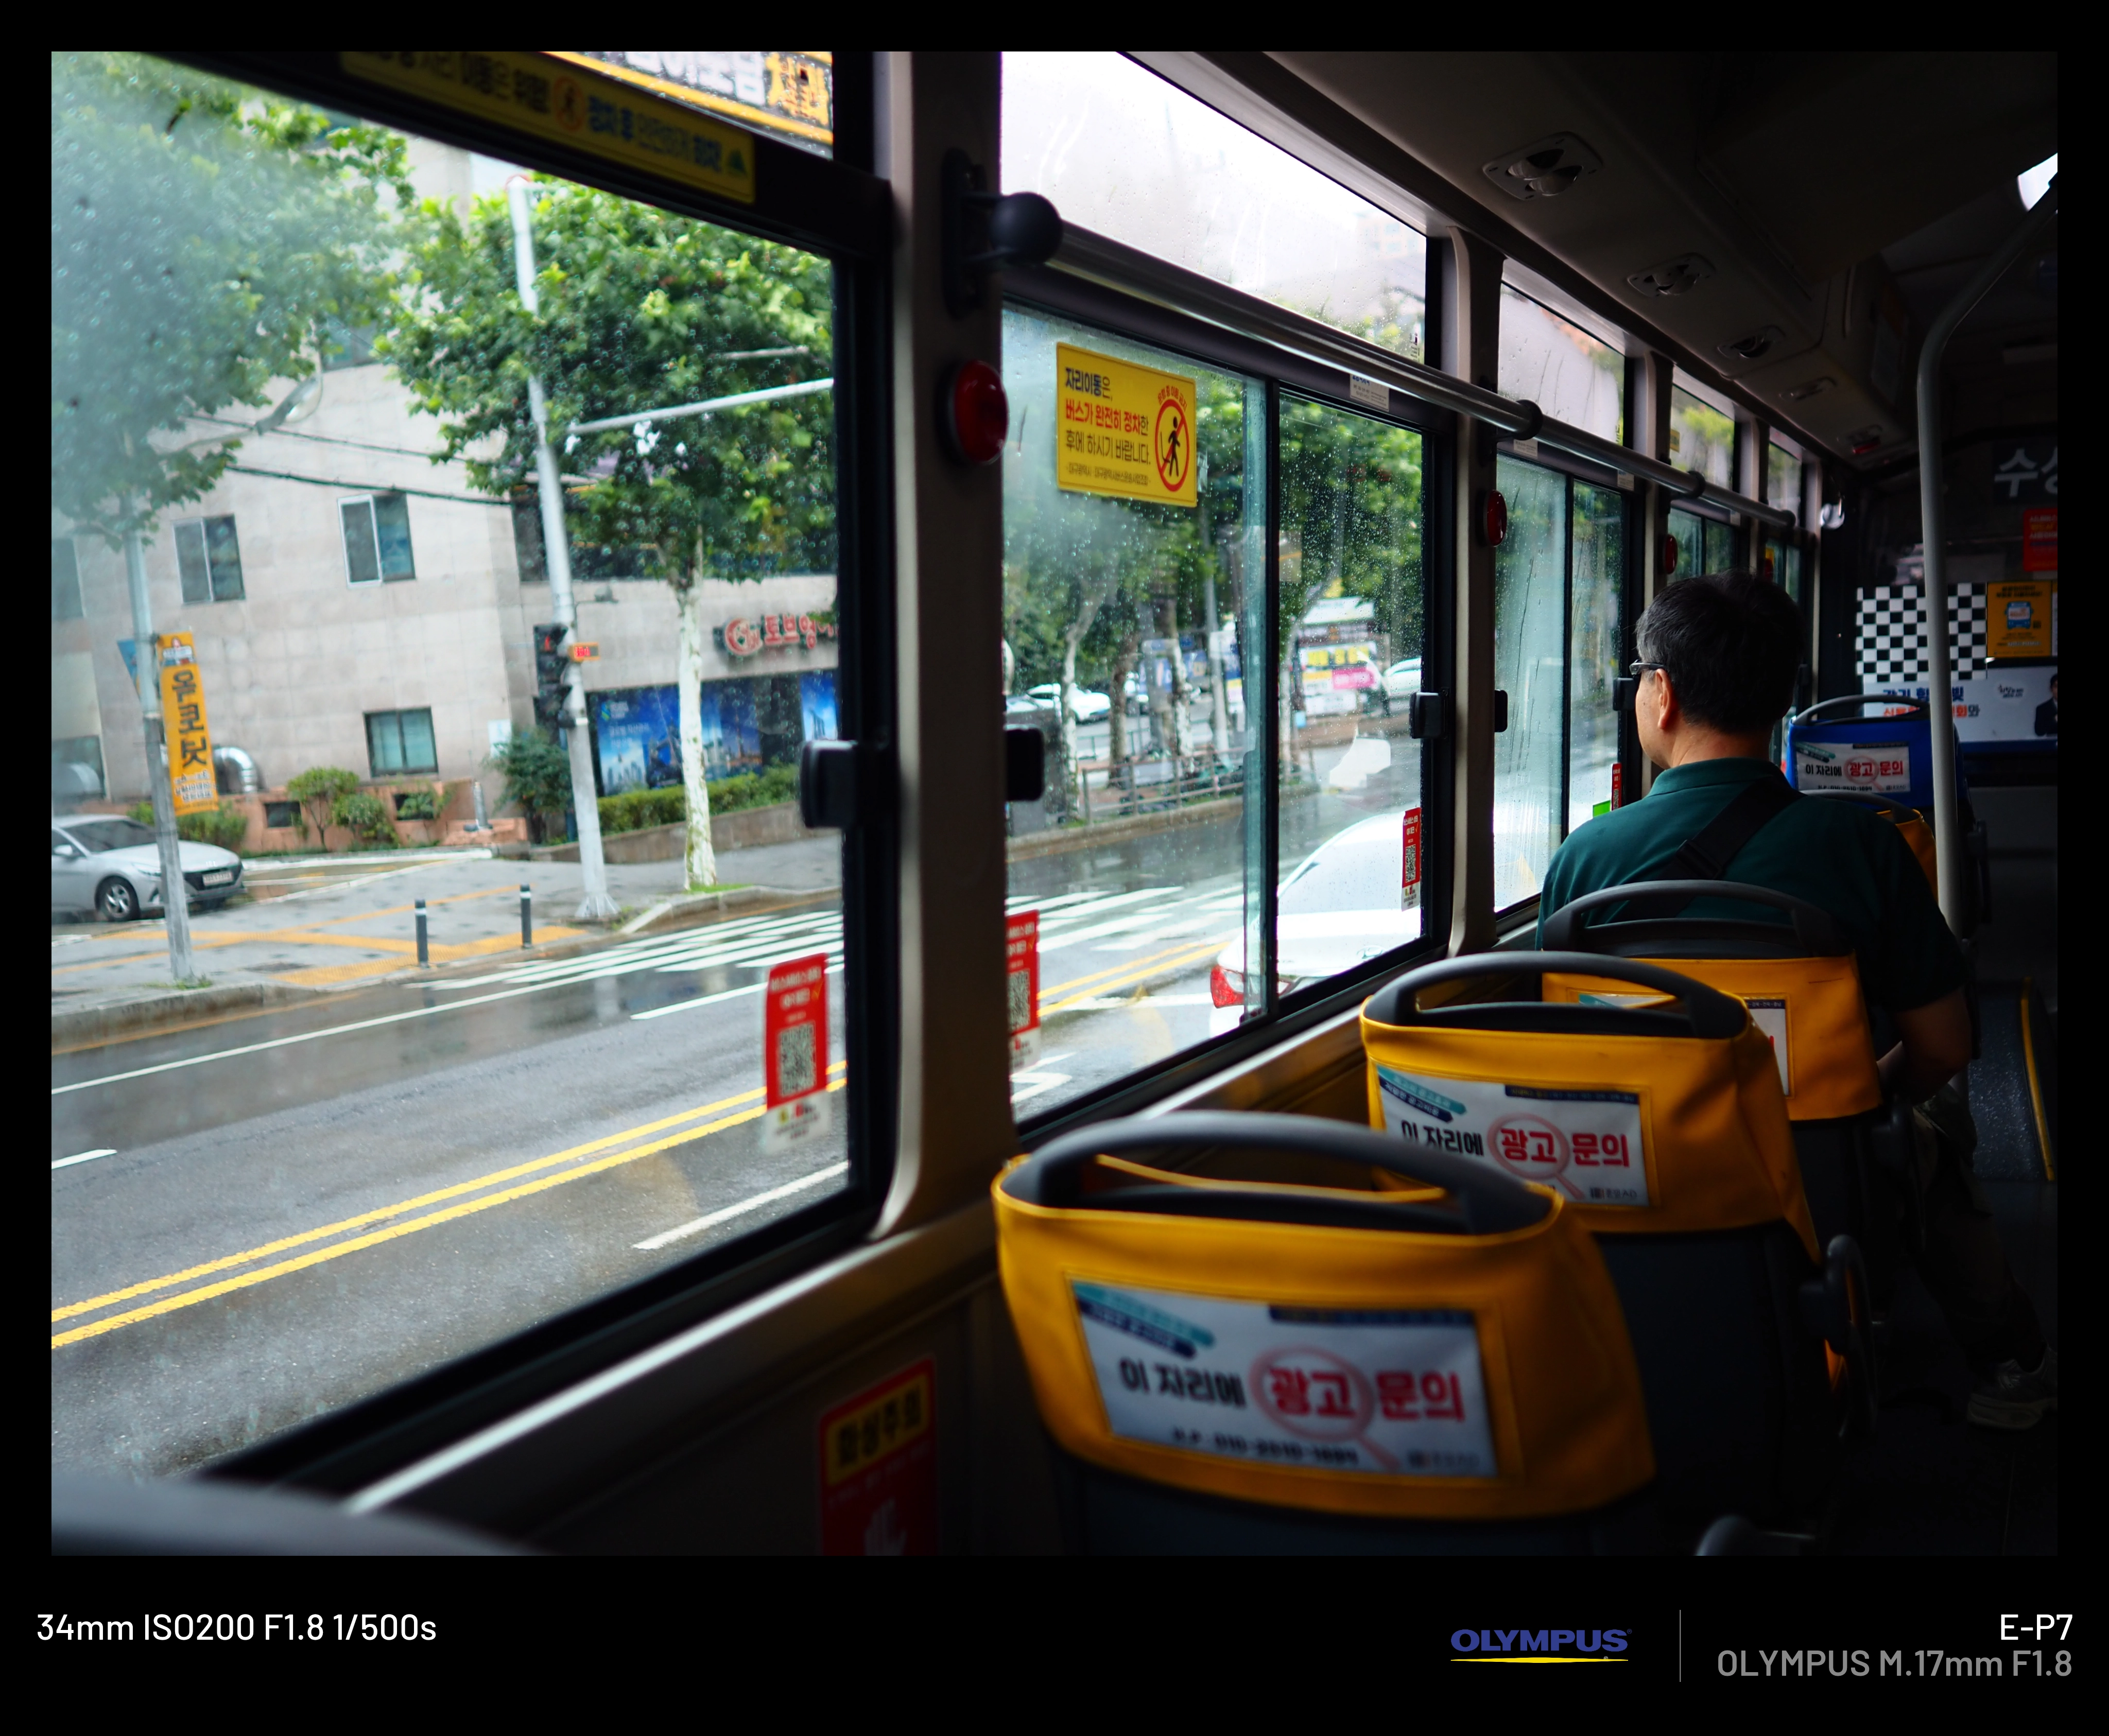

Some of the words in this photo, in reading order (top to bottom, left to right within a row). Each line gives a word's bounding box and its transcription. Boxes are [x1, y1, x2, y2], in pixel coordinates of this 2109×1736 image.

[1065, 398, 1094, 425] 버스가
[1095, 404, 1122, 430] 완전히
[1123, 411, 1149, 437] 정차한
[1065, 429, 1085, 454] 후에
[1086, 433, 1113, 458] 하시기
[1116, 440, 1151, 465] 바랍니다.
[1806, 765, 1813, 774] 이
[1816, 765, 1842, 776] 자리에
[1849, 762, 1873, 777] 광고
[1880, 760, 1904, 776] 문의
[1423, 1124, 1485, 1156] 자리에
[1500, 1127, 1558, 1164] 광고
[1572, 1132, 1630, 1168] 문의
[1119, 1358, 1149, 1395] 이
[1157, 1364, 1247, 1409] 자리에
[1269, 1367, 1356, 1418] 광고
[1375, 1370, 1465, 1422] 문의
